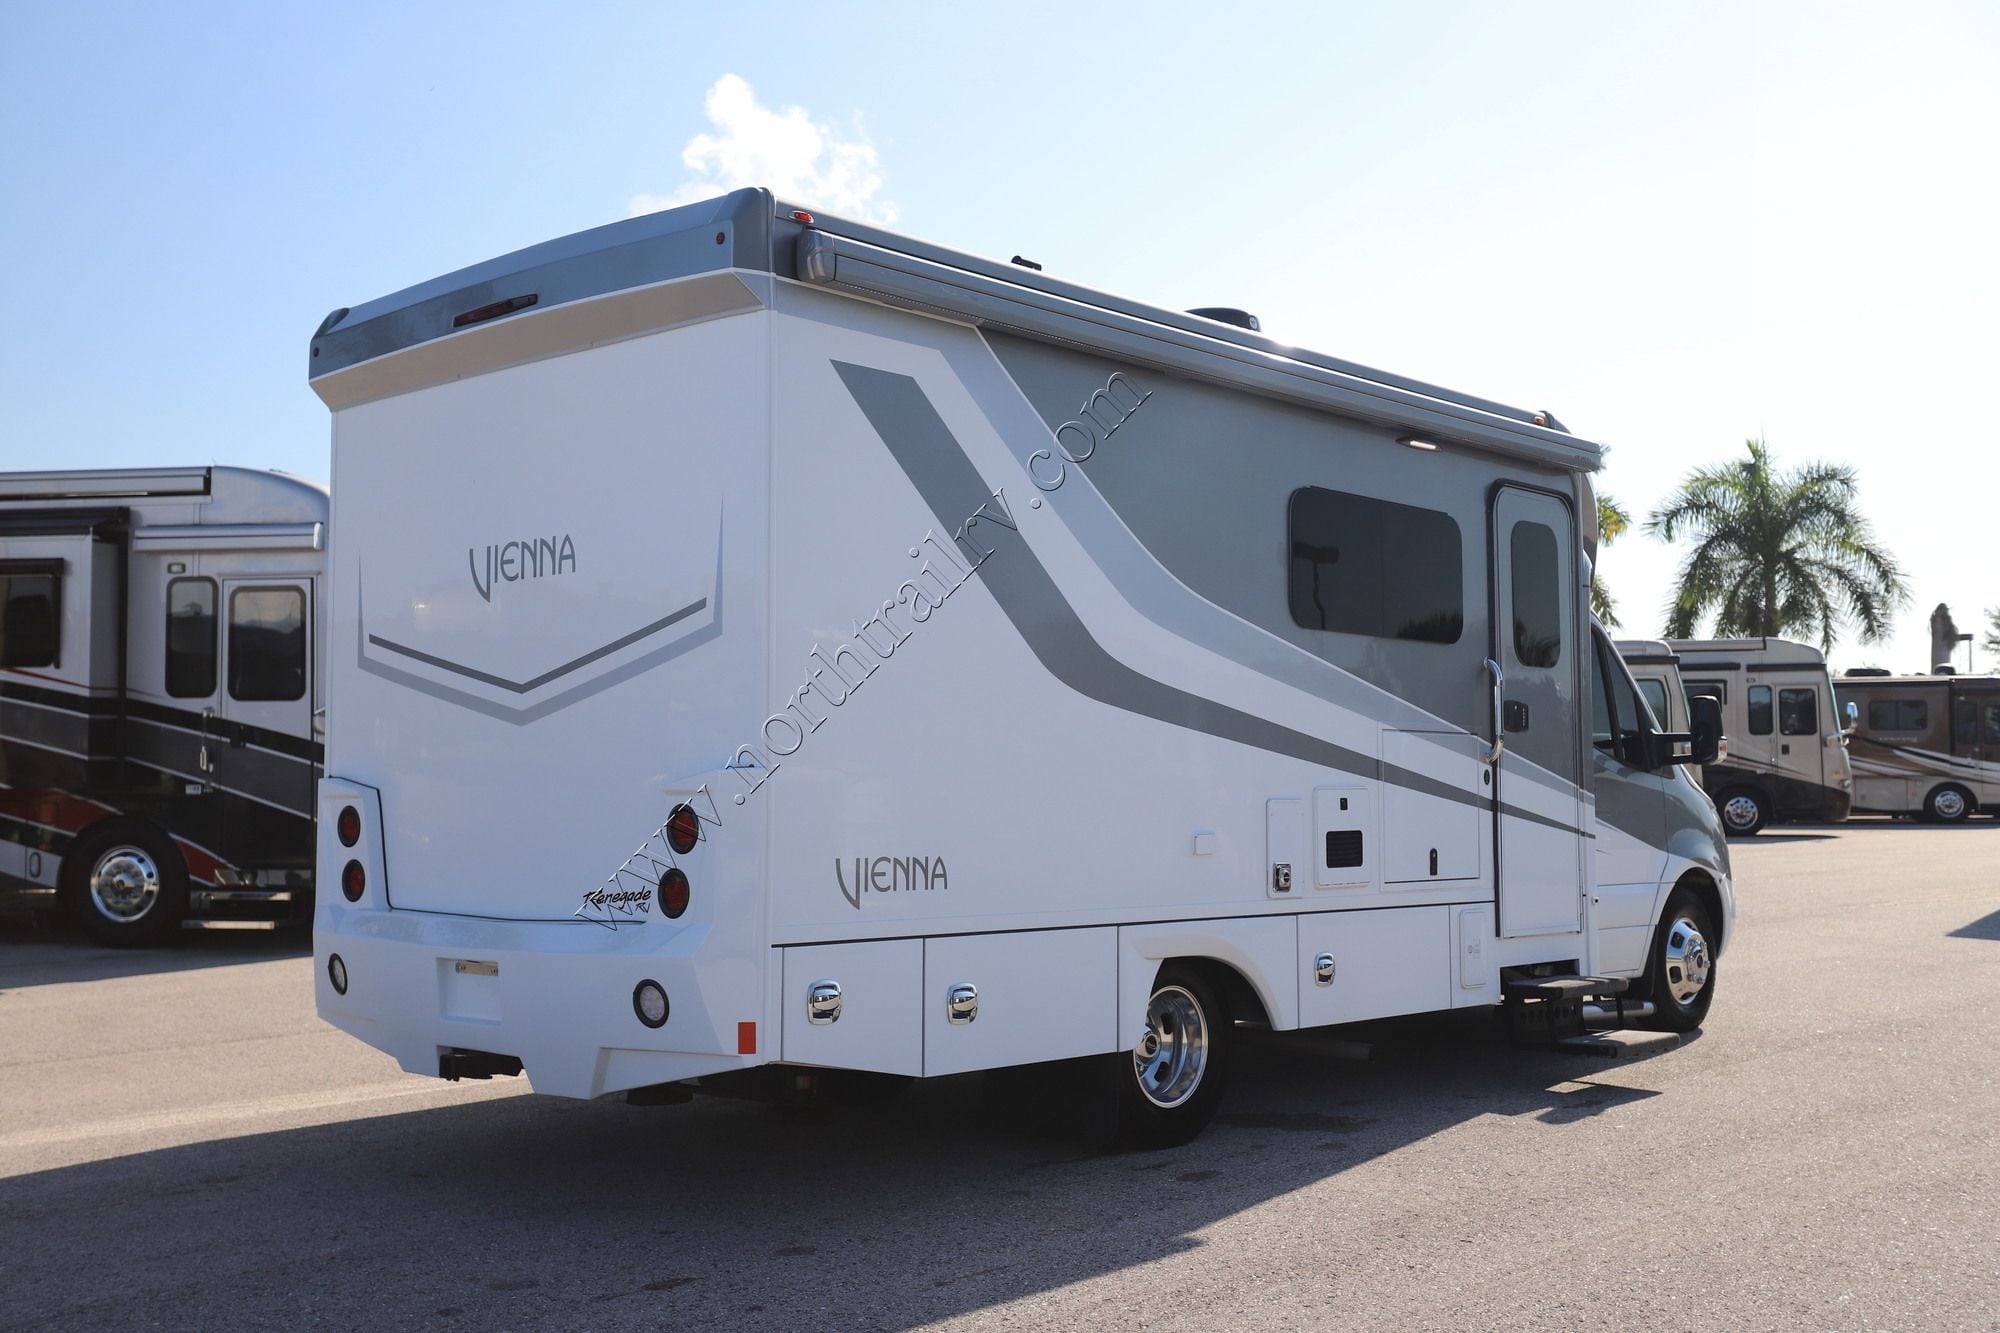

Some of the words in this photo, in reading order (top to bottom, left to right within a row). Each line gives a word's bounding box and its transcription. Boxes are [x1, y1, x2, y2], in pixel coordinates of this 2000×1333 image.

[469, 534, 576, 603] VIENNA
[583, 885, 652, 911] Renegade
[835, 856, 948, 910] VIENNA
